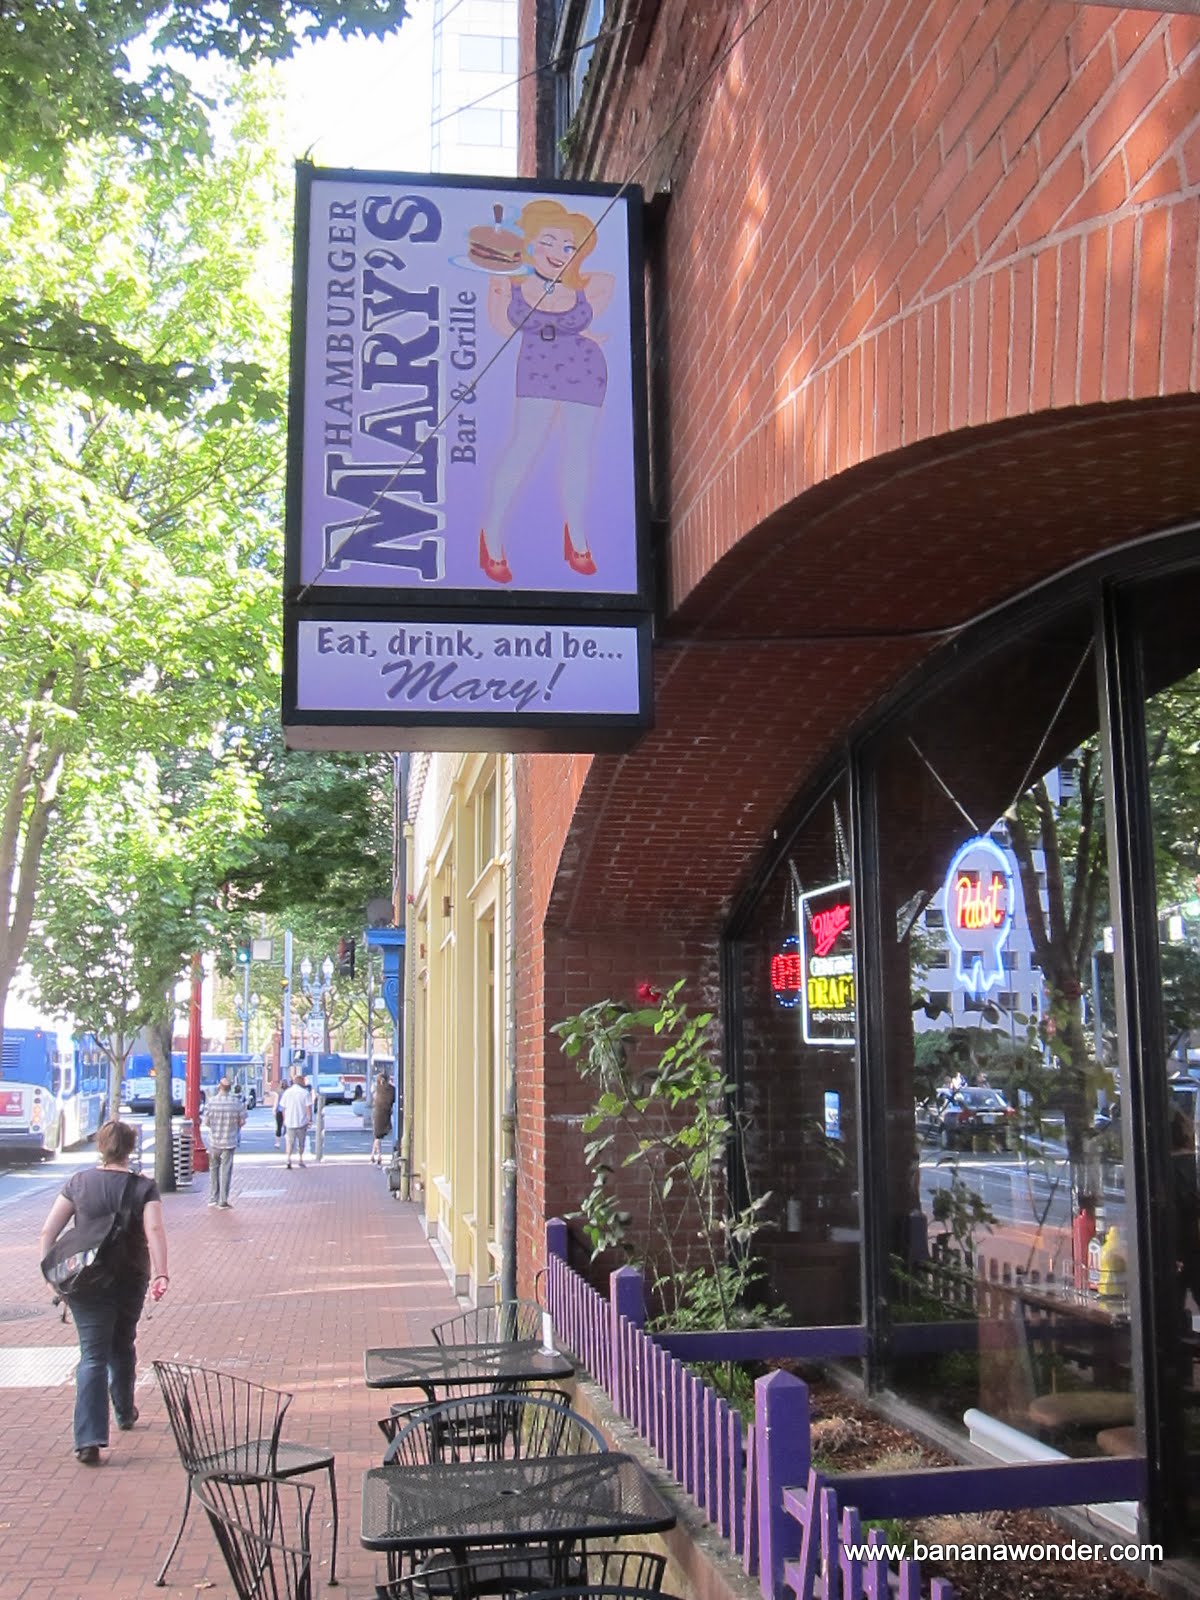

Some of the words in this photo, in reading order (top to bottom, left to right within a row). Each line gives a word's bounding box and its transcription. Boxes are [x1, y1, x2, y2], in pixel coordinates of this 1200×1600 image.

[324, 199, 357, 449] HAMBURGER
[449, 291, 477, 370] Grille
[324, 194, 443, 581] MARY'S
[450, 380, 477, 404] &
[450, 414, 477, 465] Bar
[317, 626, 378, 658] Eat,
[387, 627, 484, 660] drink,
[493, 631, 552, 659] and
[562, 631, 624, 660] be...
[380, 658, 567, 712] Mary!
[954, 875, 1004, 929] Pabst
